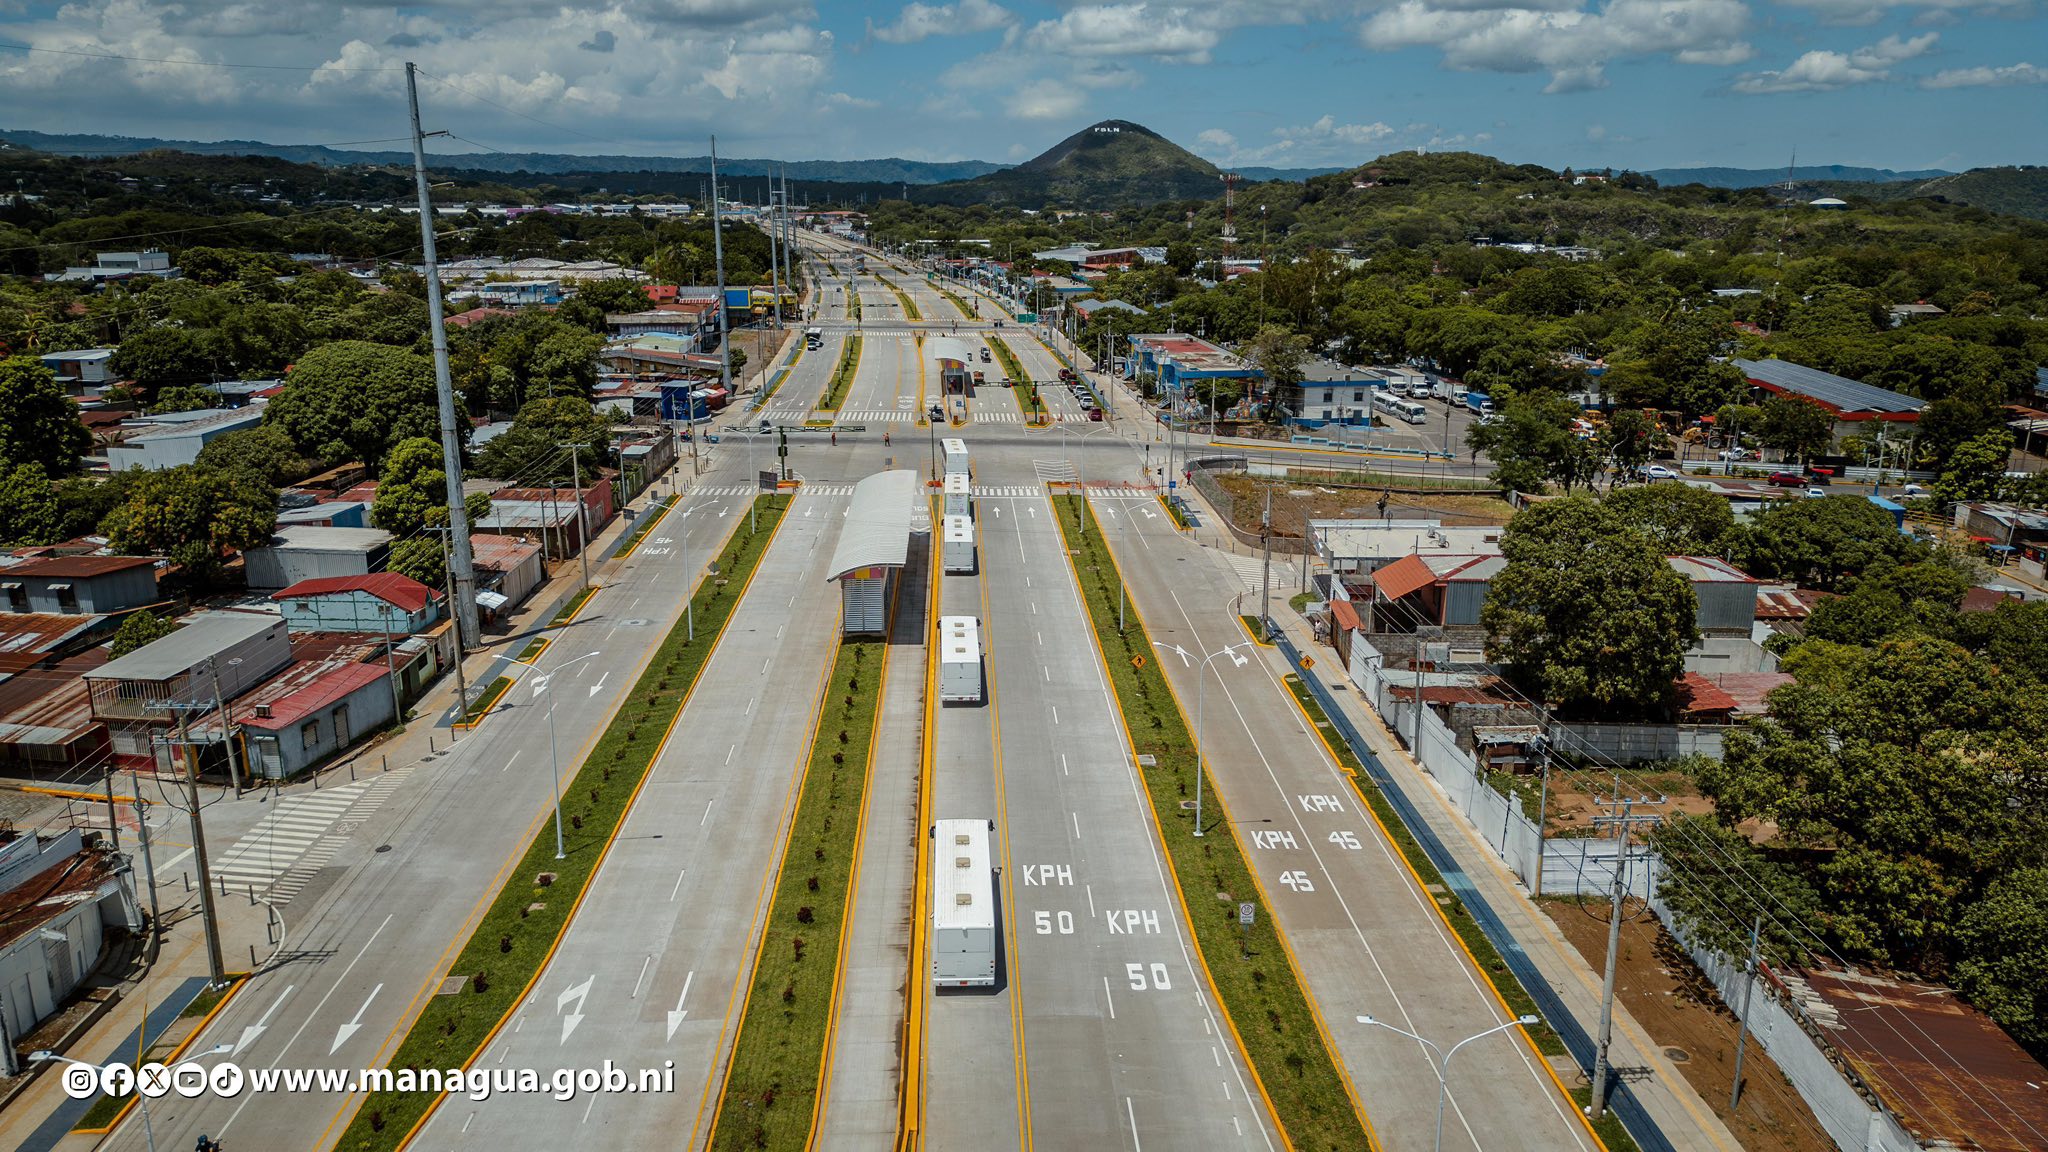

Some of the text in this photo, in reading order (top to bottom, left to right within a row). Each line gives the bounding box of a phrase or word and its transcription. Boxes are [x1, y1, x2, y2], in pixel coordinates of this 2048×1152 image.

[1298, 795, 1345, 812] KPH
[1250, 831, 1300, 850] KPH
[1328, 831, 1363, 850] 45
[1023, 865, 1073, 886] KPH
[1279, 870, 1315, 892] 45
[1035, 911, 1074, 935] 50
[1106, 910, 1161, 934] KPH
[1126, 963, 1172, 991] 50
